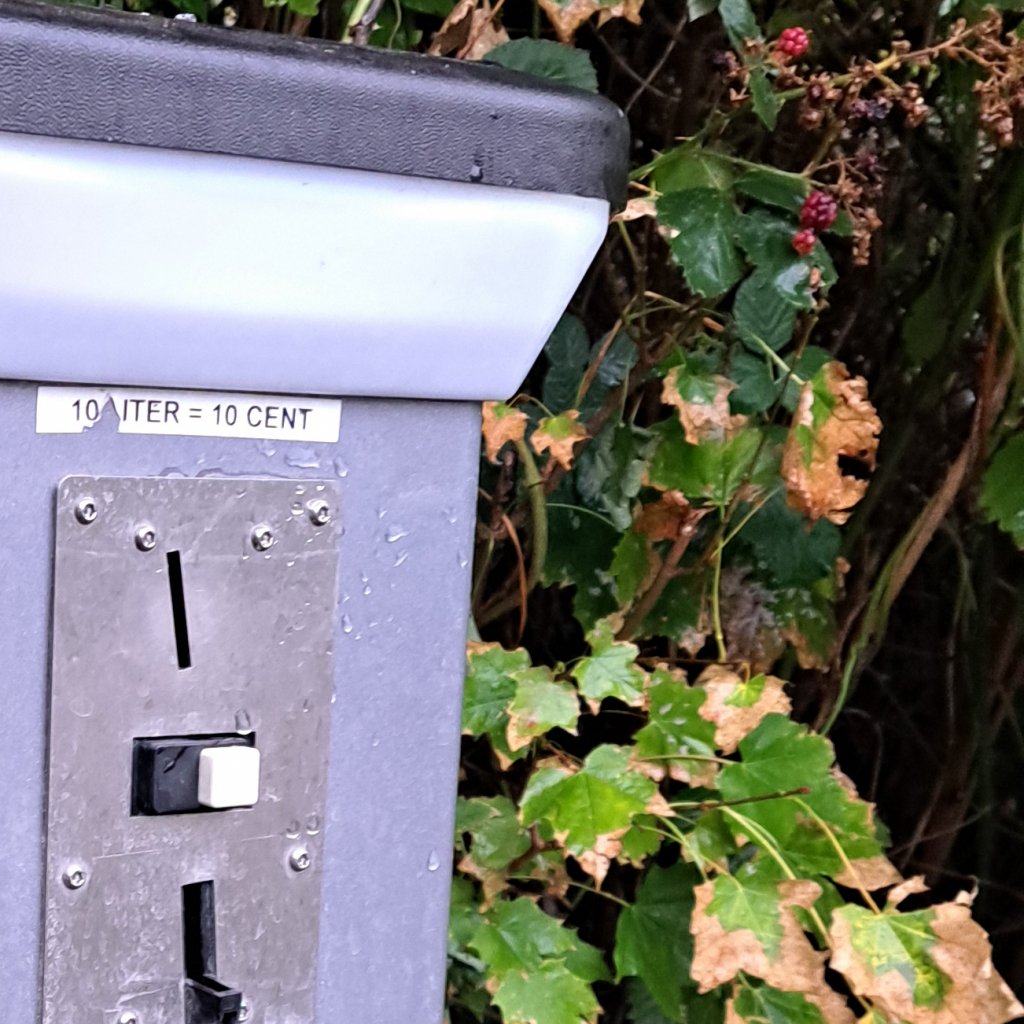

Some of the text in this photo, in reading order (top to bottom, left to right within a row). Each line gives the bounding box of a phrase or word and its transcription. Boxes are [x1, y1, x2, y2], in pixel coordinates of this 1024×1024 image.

[72, 398, 100, 422] 10
[108, 398, 180, 424] ITER
[212, 403, 238, 427] 10
[246, 405, 314, 430] CENT
